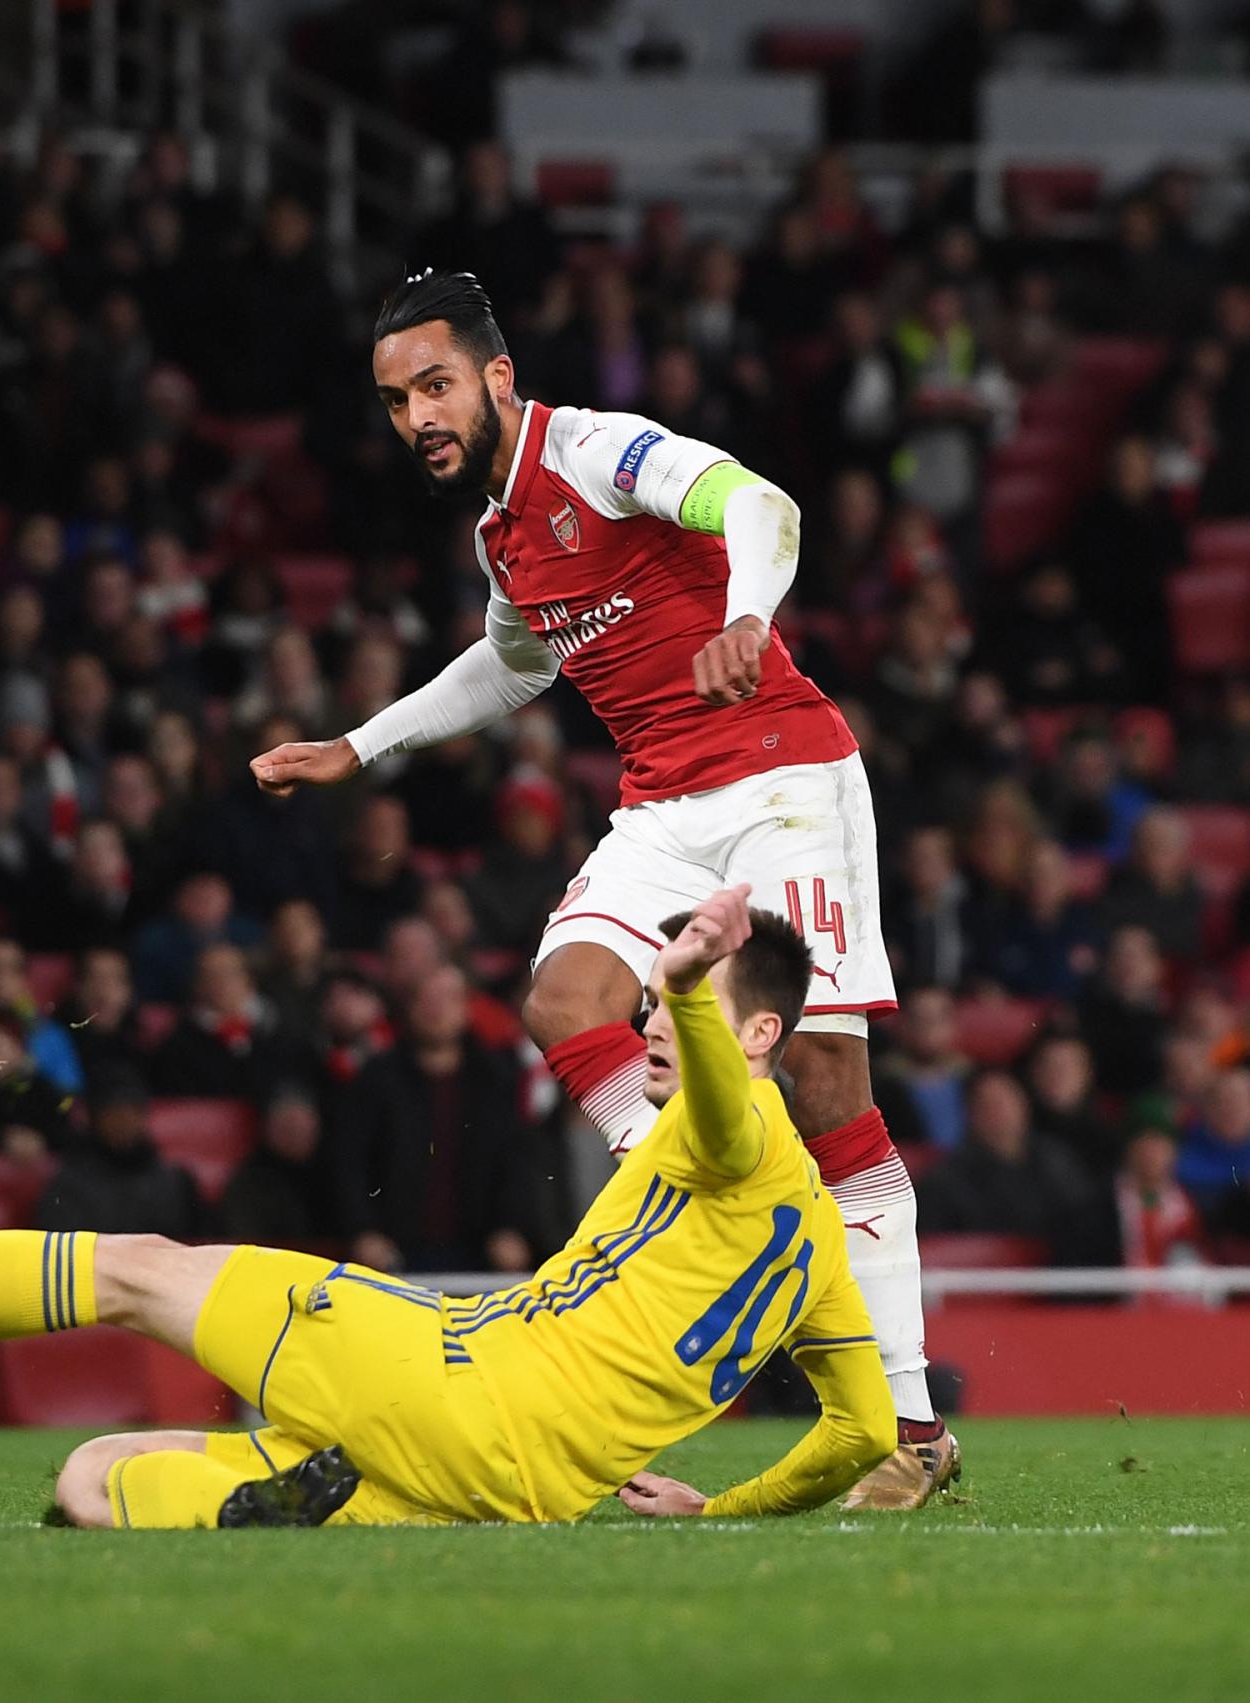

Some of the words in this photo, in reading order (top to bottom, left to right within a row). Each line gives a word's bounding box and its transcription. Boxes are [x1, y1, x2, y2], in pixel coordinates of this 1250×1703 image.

[623, 431, 661, 471] RESPECT
[538, 600, 572, 631] Fly
[548, 591, 635, 661] mirates
[784, 877, 847, 954] 14
